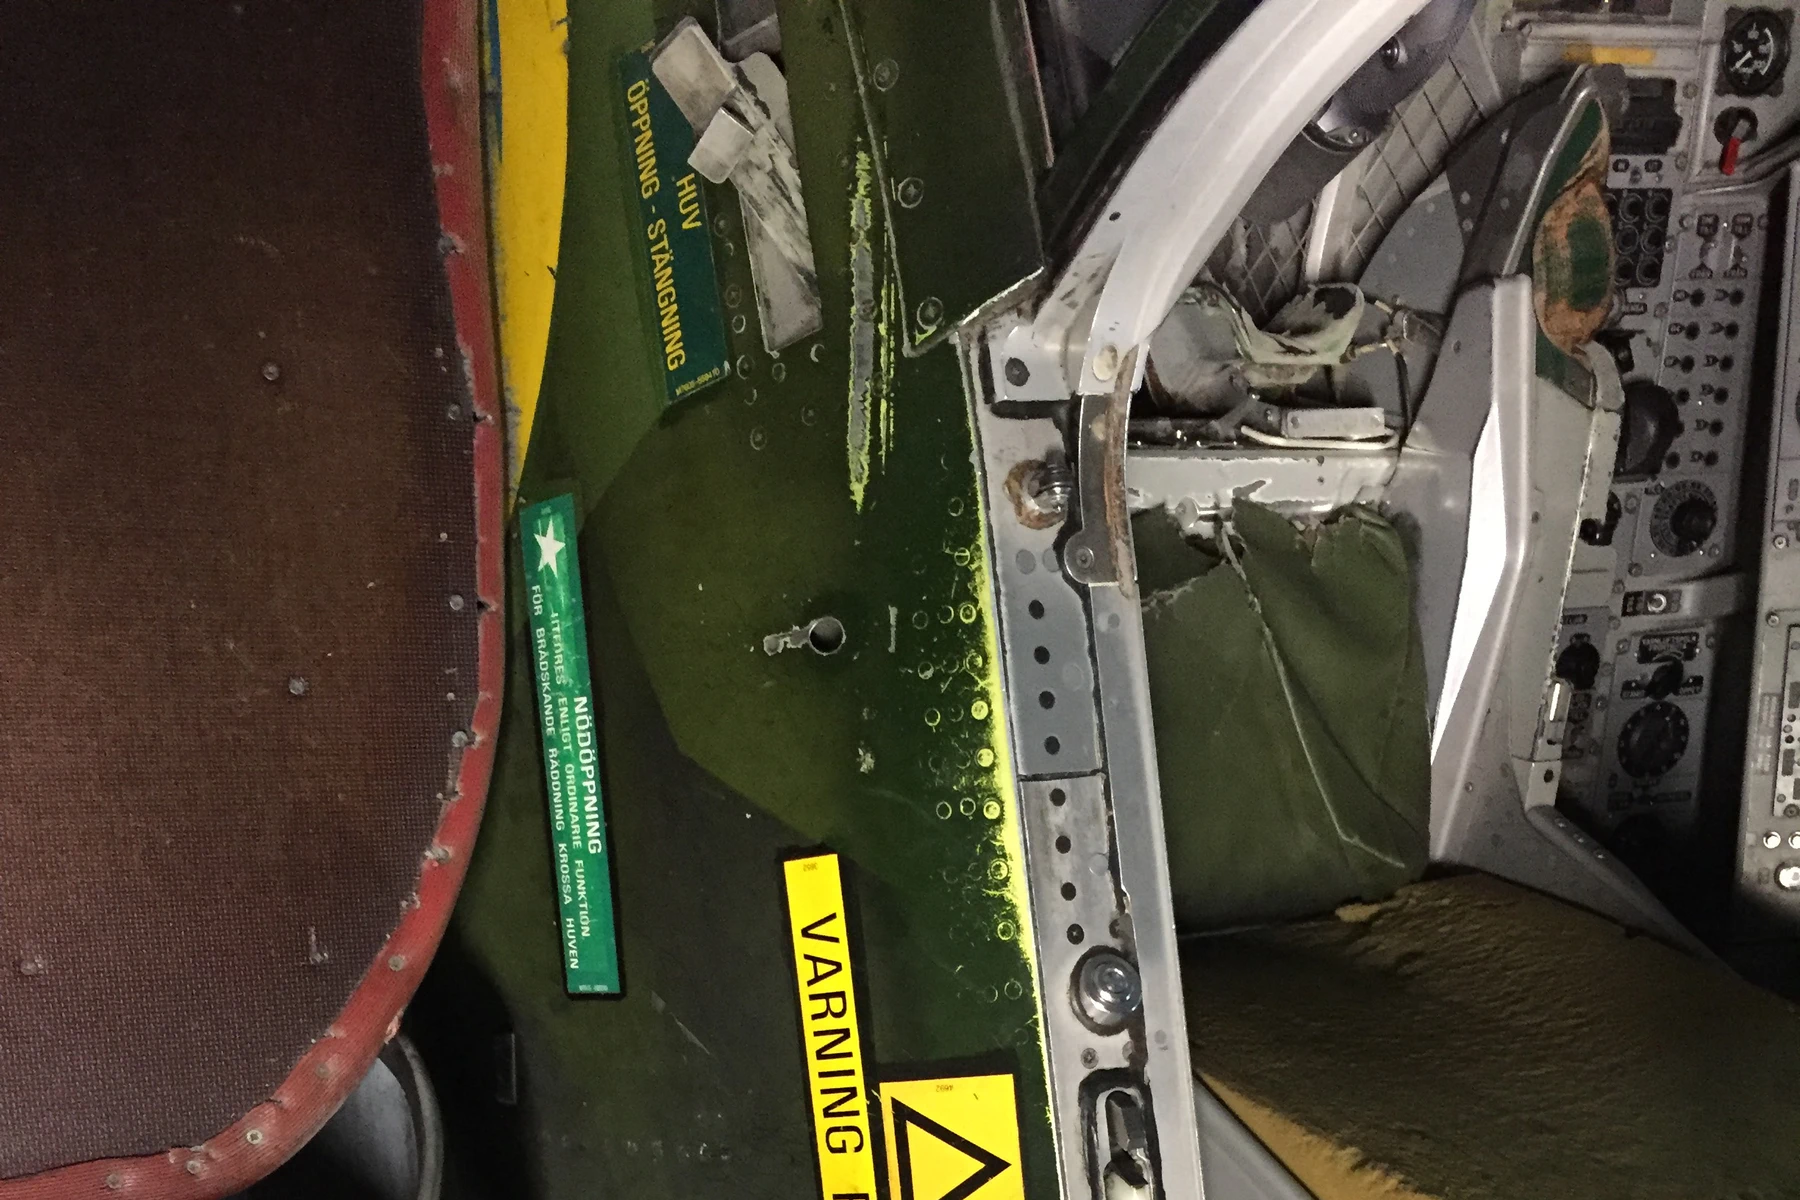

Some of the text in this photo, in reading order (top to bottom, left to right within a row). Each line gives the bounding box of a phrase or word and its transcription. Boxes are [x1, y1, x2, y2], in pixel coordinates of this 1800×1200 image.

[627, 78, 660, 199] ÖPPNING
[647, 218, 686, 371] STÄNGNING
[676, 173, 702, 230] HUV
[532, 585, 579, 969] FÖR BRÅDSKANDE RÄDDNING KROSSA HUVEN
[558, 697, 573, 752] ENLIGT
[573, 697, 602, 854] NÖDÖPPNING
[565, 763, 582, 849] ORDINARIE
[575, 860, 590, 937] FUNKTION
[801, 912, 864, 1154] VARNING
